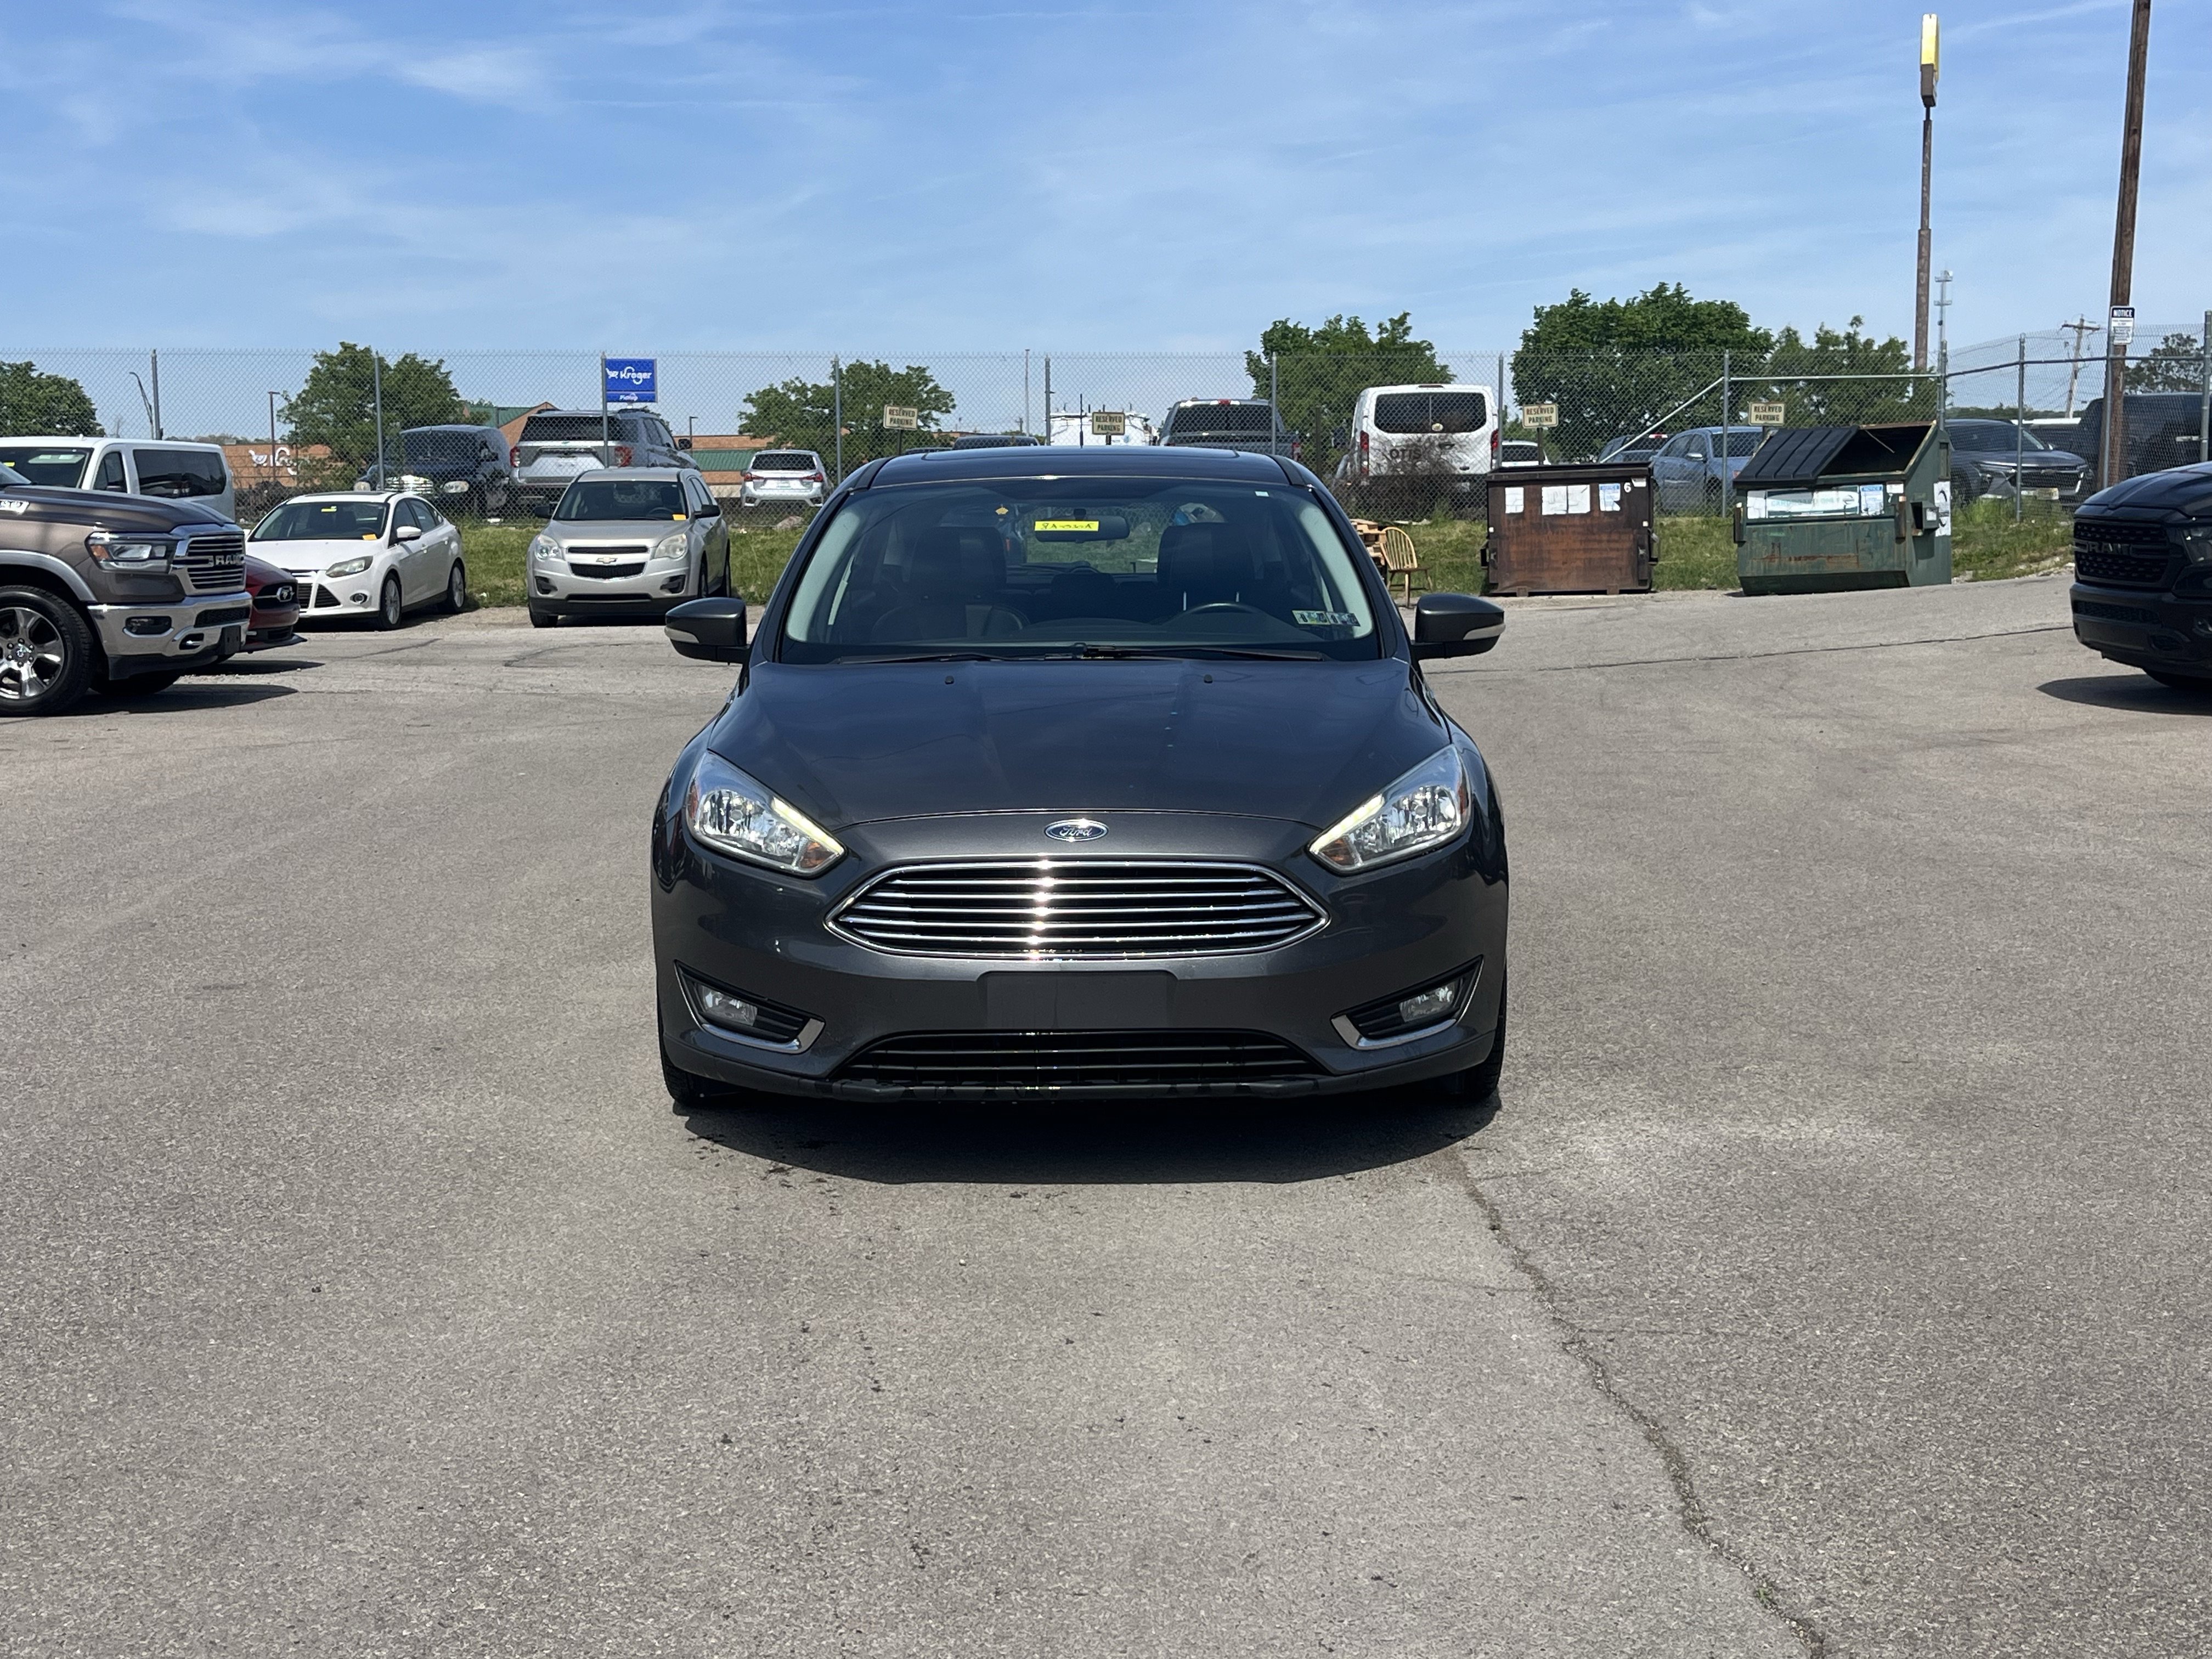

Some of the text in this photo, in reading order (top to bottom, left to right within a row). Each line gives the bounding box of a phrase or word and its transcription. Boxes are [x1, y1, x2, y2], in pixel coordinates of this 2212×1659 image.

[620, 366, 652, 385] Kroger
[889, 408, 915, 417] RESERVED
[1526, 407, 1554, 415] RESERVED
[889, 417, 913, 426] PARKING
[1528, 415, 1553, 424] PARKING
[1390, 448, 1421, 460] OTIS
[1624, 482, 1631, 493] 6
[2089, 541, 2130, 555] RAM
[216, 554, 245, 566] RAM
[1059, 825, 1092, 837] Ford
